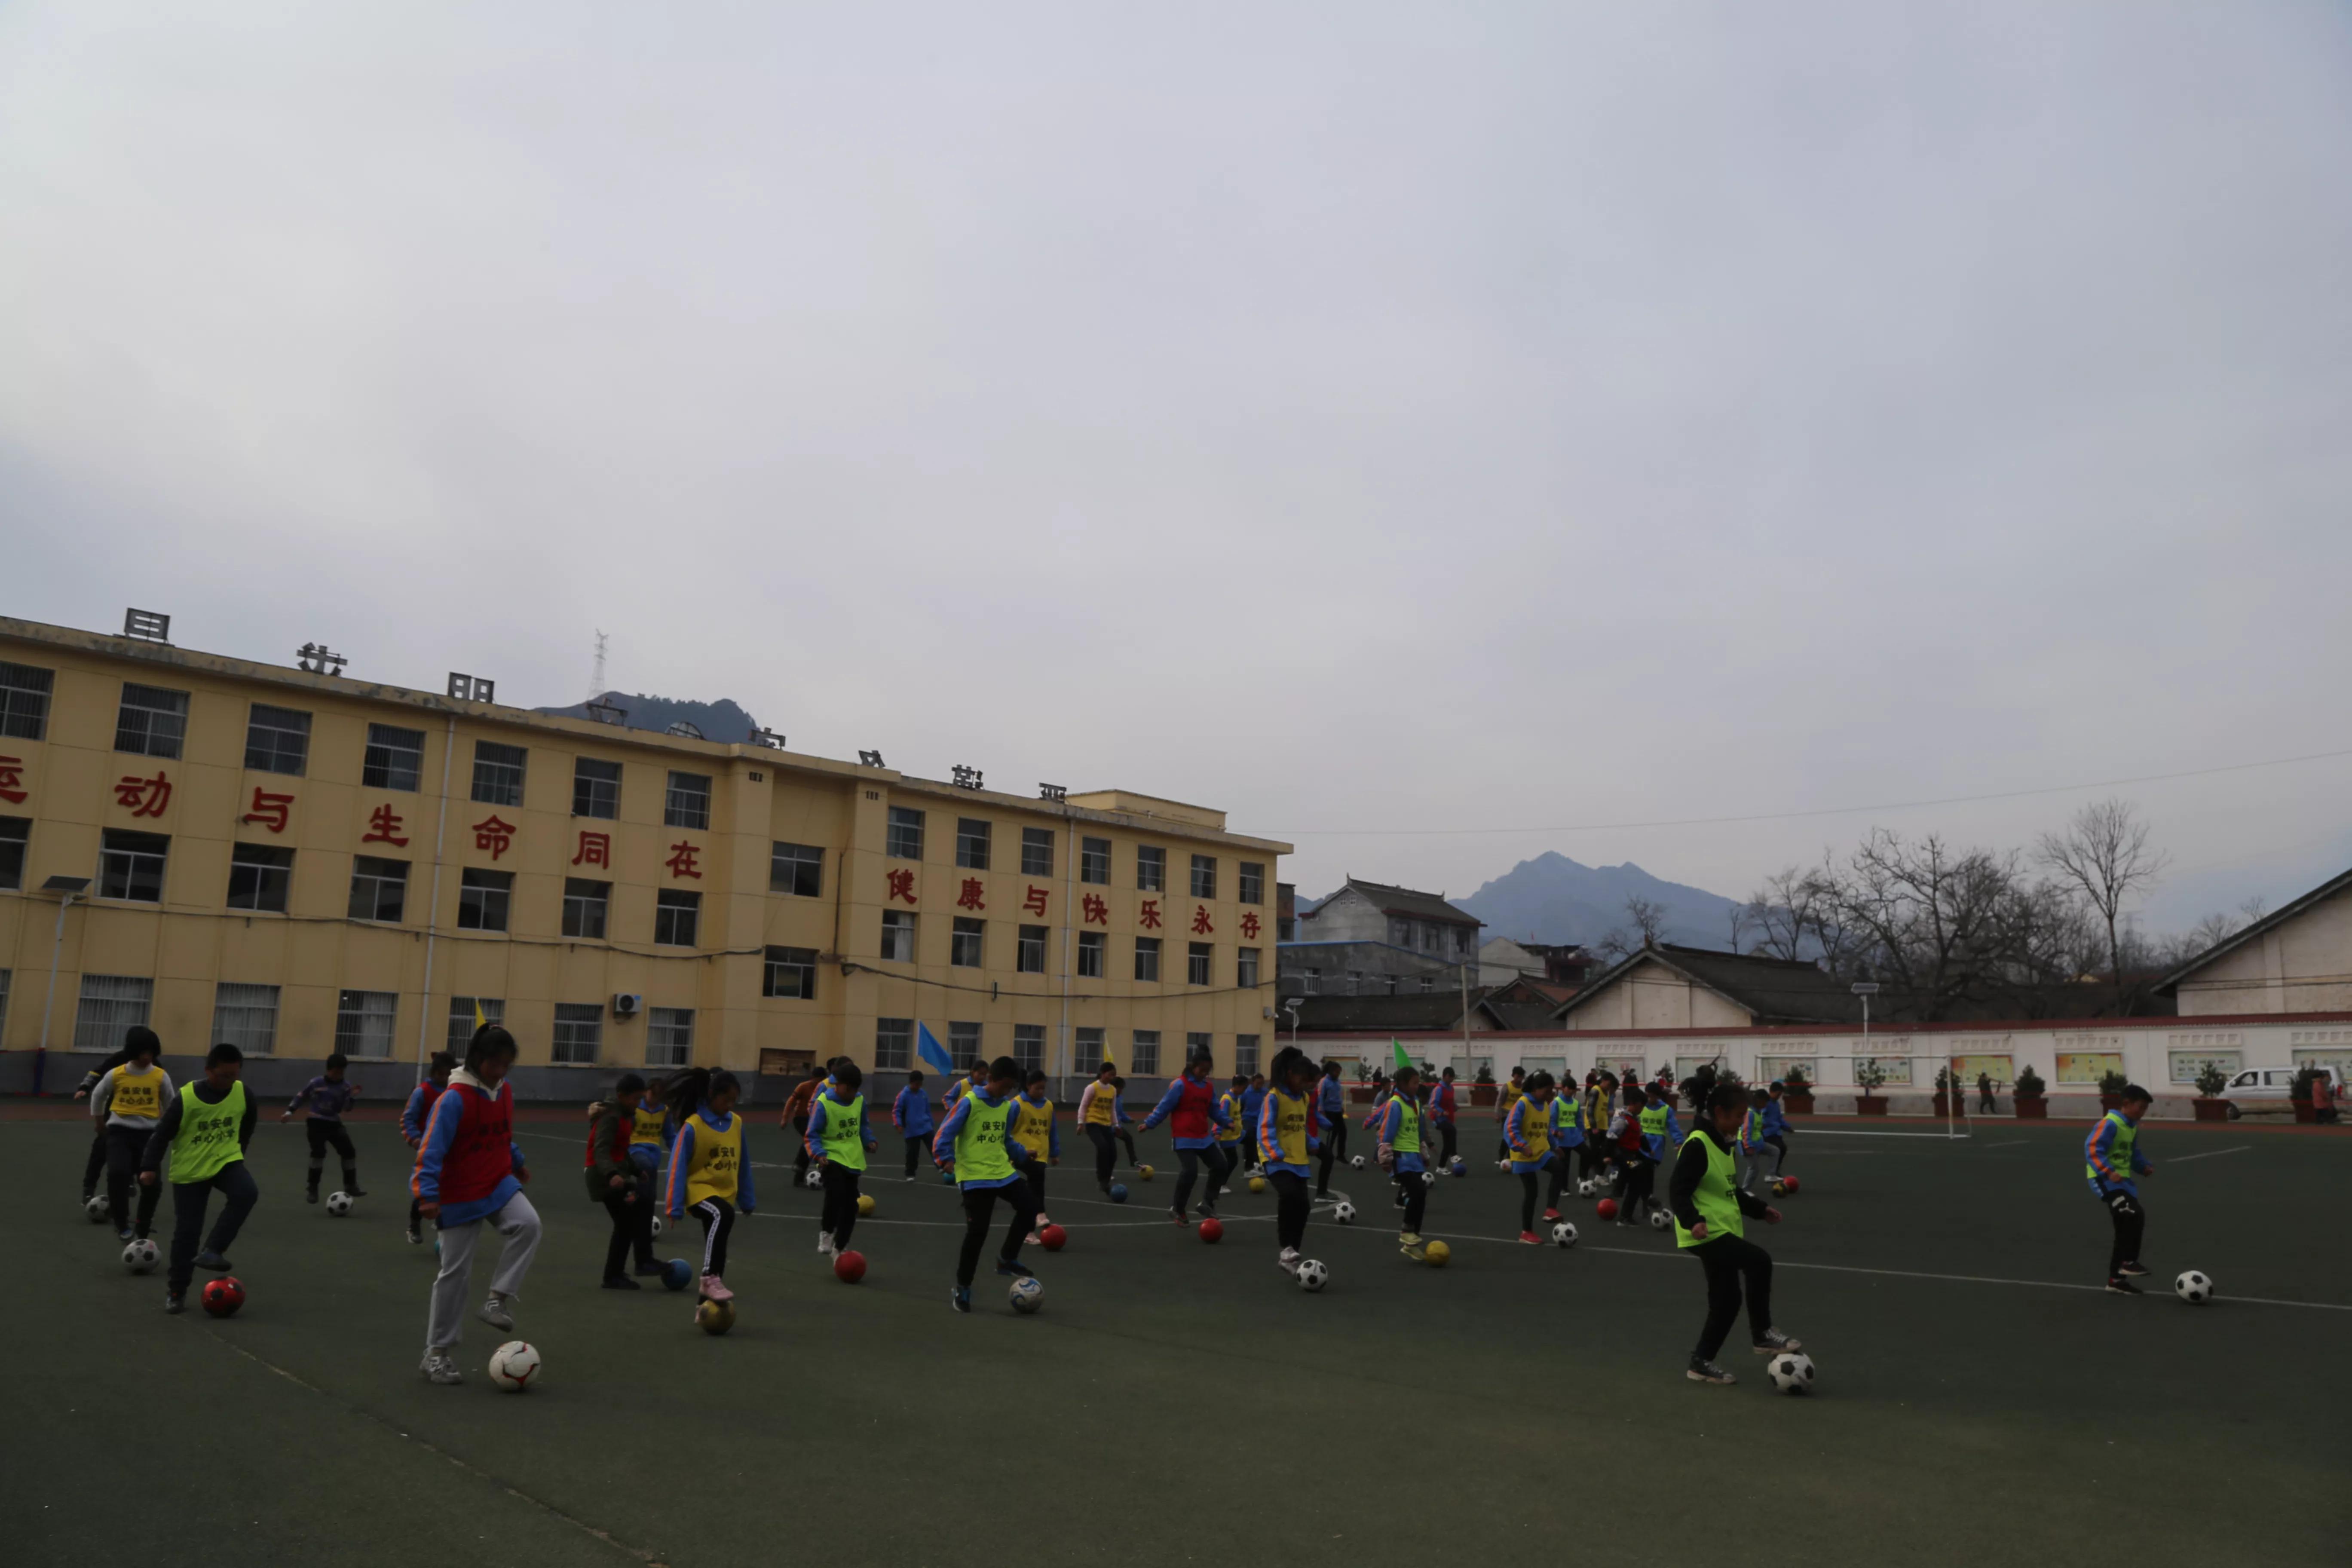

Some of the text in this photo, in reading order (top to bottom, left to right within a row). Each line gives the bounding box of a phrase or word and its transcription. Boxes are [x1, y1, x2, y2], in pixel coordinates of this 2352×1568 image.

[887, 869, 1261, 939] 健康与快乐永存
